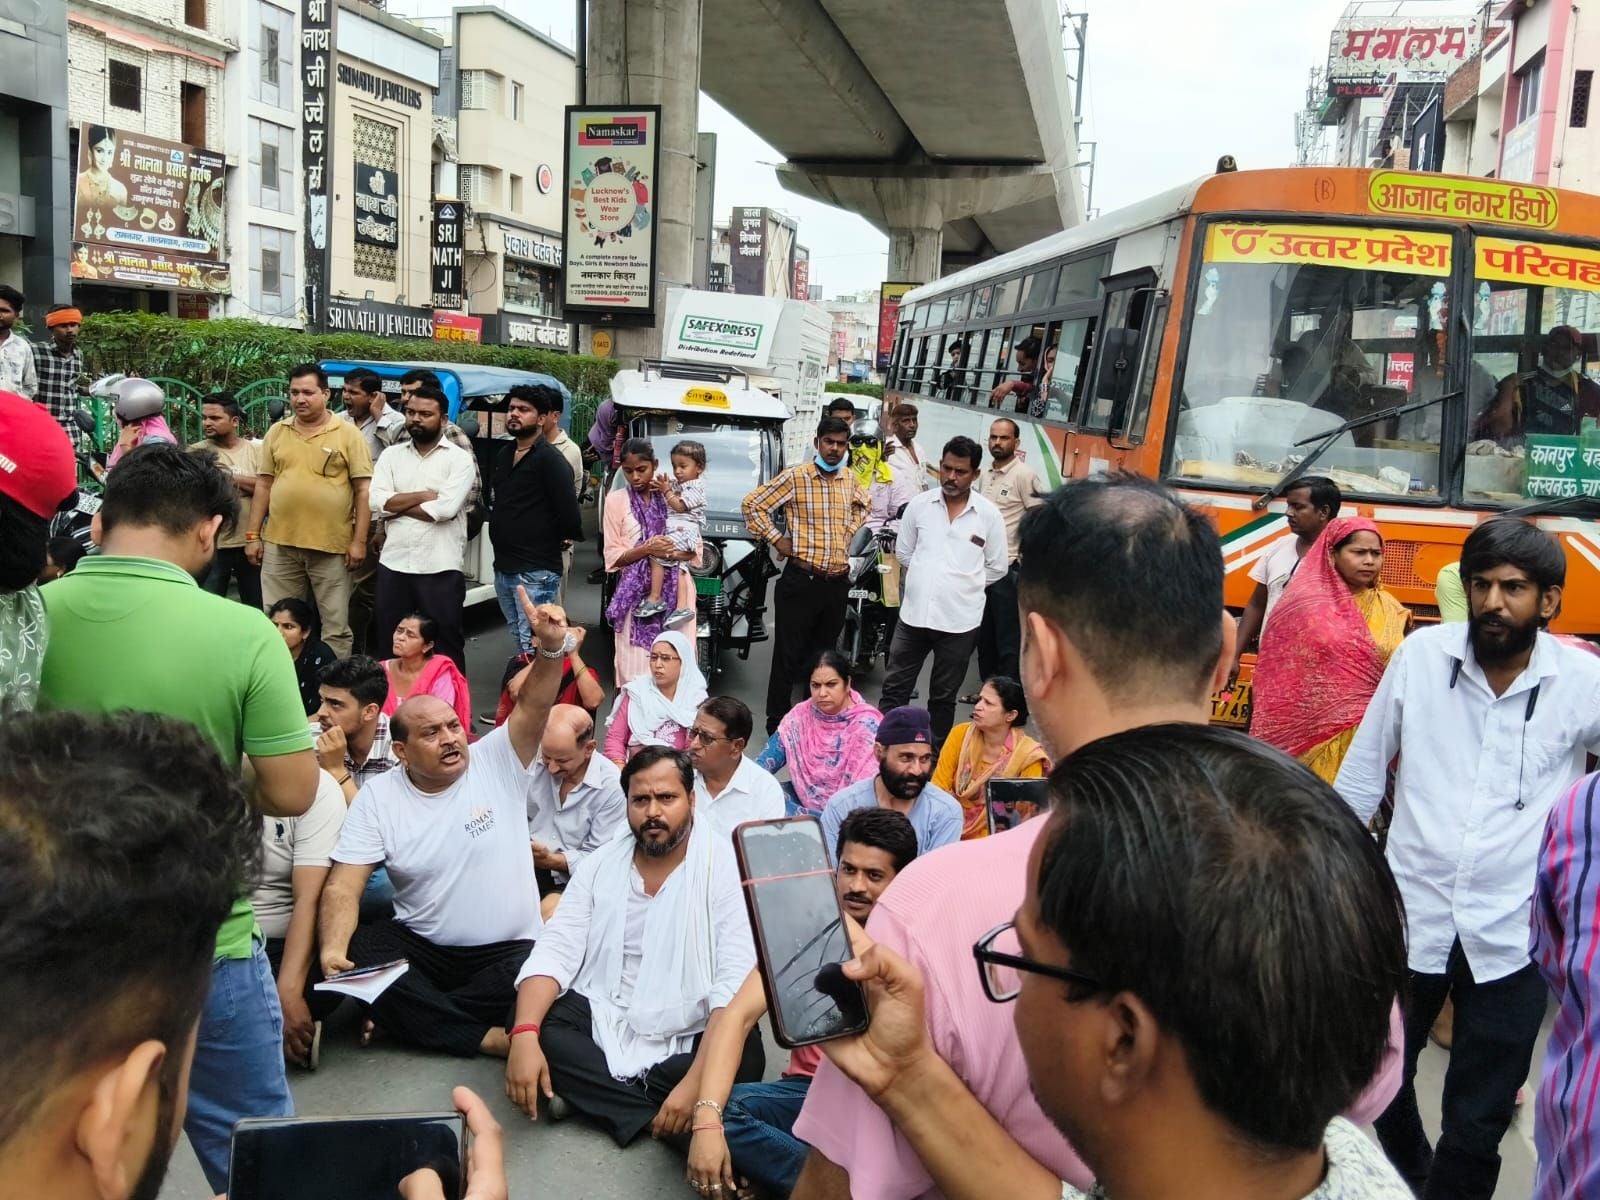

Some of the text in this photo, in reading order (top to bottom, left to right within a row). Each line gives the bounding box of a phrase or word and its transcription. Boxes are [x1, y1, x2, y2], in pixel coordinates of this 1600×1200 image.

[303, 29, 331, 51] नाथ
[306, 55, 326, 88] जी
[337, 62, 351, 86] SRI
[351, 67, 374, 95] NATH
[380, 79, 422, 111] JEWELLERS
[588, 126, 637, 138] Namaskar
[591, 187, 630, 195] Lucknow's
[593, 196, 628, 204] Best Kids
[600, 205, 620, 213] Wear
[1377, 183, 1551, 225] आजाद नगर डिपो
[599, 214, 620, 222] Store
[438, 224, 457, 243] SRI
[432, 247, 462, 267] NATH
[1269, 233, 1361, 260] उत्तर
[1366, 234, 1449, 269] प्रदेश
[441, 270, 452, 289] JI
[580, 271, 612, 280] नमस्कार
[432, 293, 462, 309] JEWELLERS
[328, 307, 346, 329] SRI
[347, 310, 376, 332] NATH
[385, 314, 433, 338] JEWELLERS
[688, 319, 757, 338] SAFEXPRESS
[678, 343, 757, 360] Distribution Redefined
[1531, 444, 1577, 473] कानपुर
[1527, 476, 1577, 498] लखनऊ
[715, 524, 739, 533] LIFE
